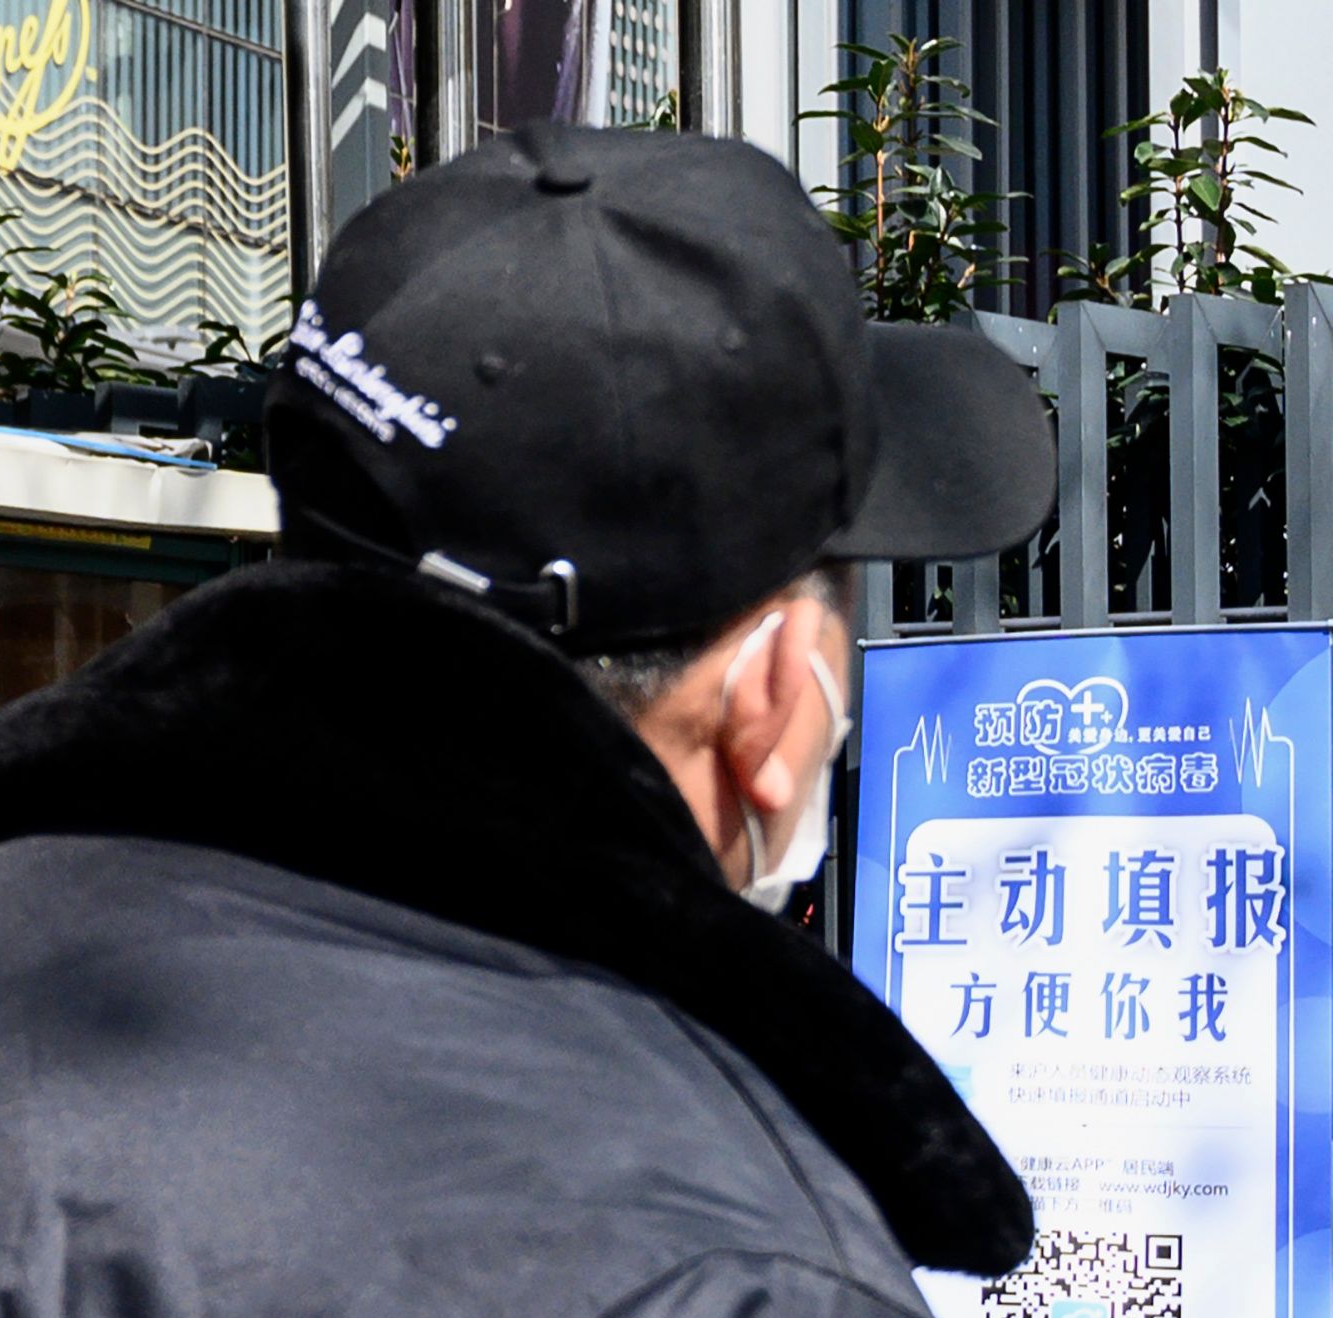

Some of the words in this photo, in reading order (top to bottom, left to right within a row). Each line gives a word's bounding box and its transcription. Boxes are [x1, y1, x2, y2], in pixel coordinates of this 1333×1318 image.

[974, 700, 1063, 747] 预防
[967, 752, 1219, 798] 新型冠状病毒
[899, 848, 1281, 950] 主动填报
[949, 970, 1229, 1043] 方便你我
[1099, 1179, 1229, 1198] www.wdjky.com
